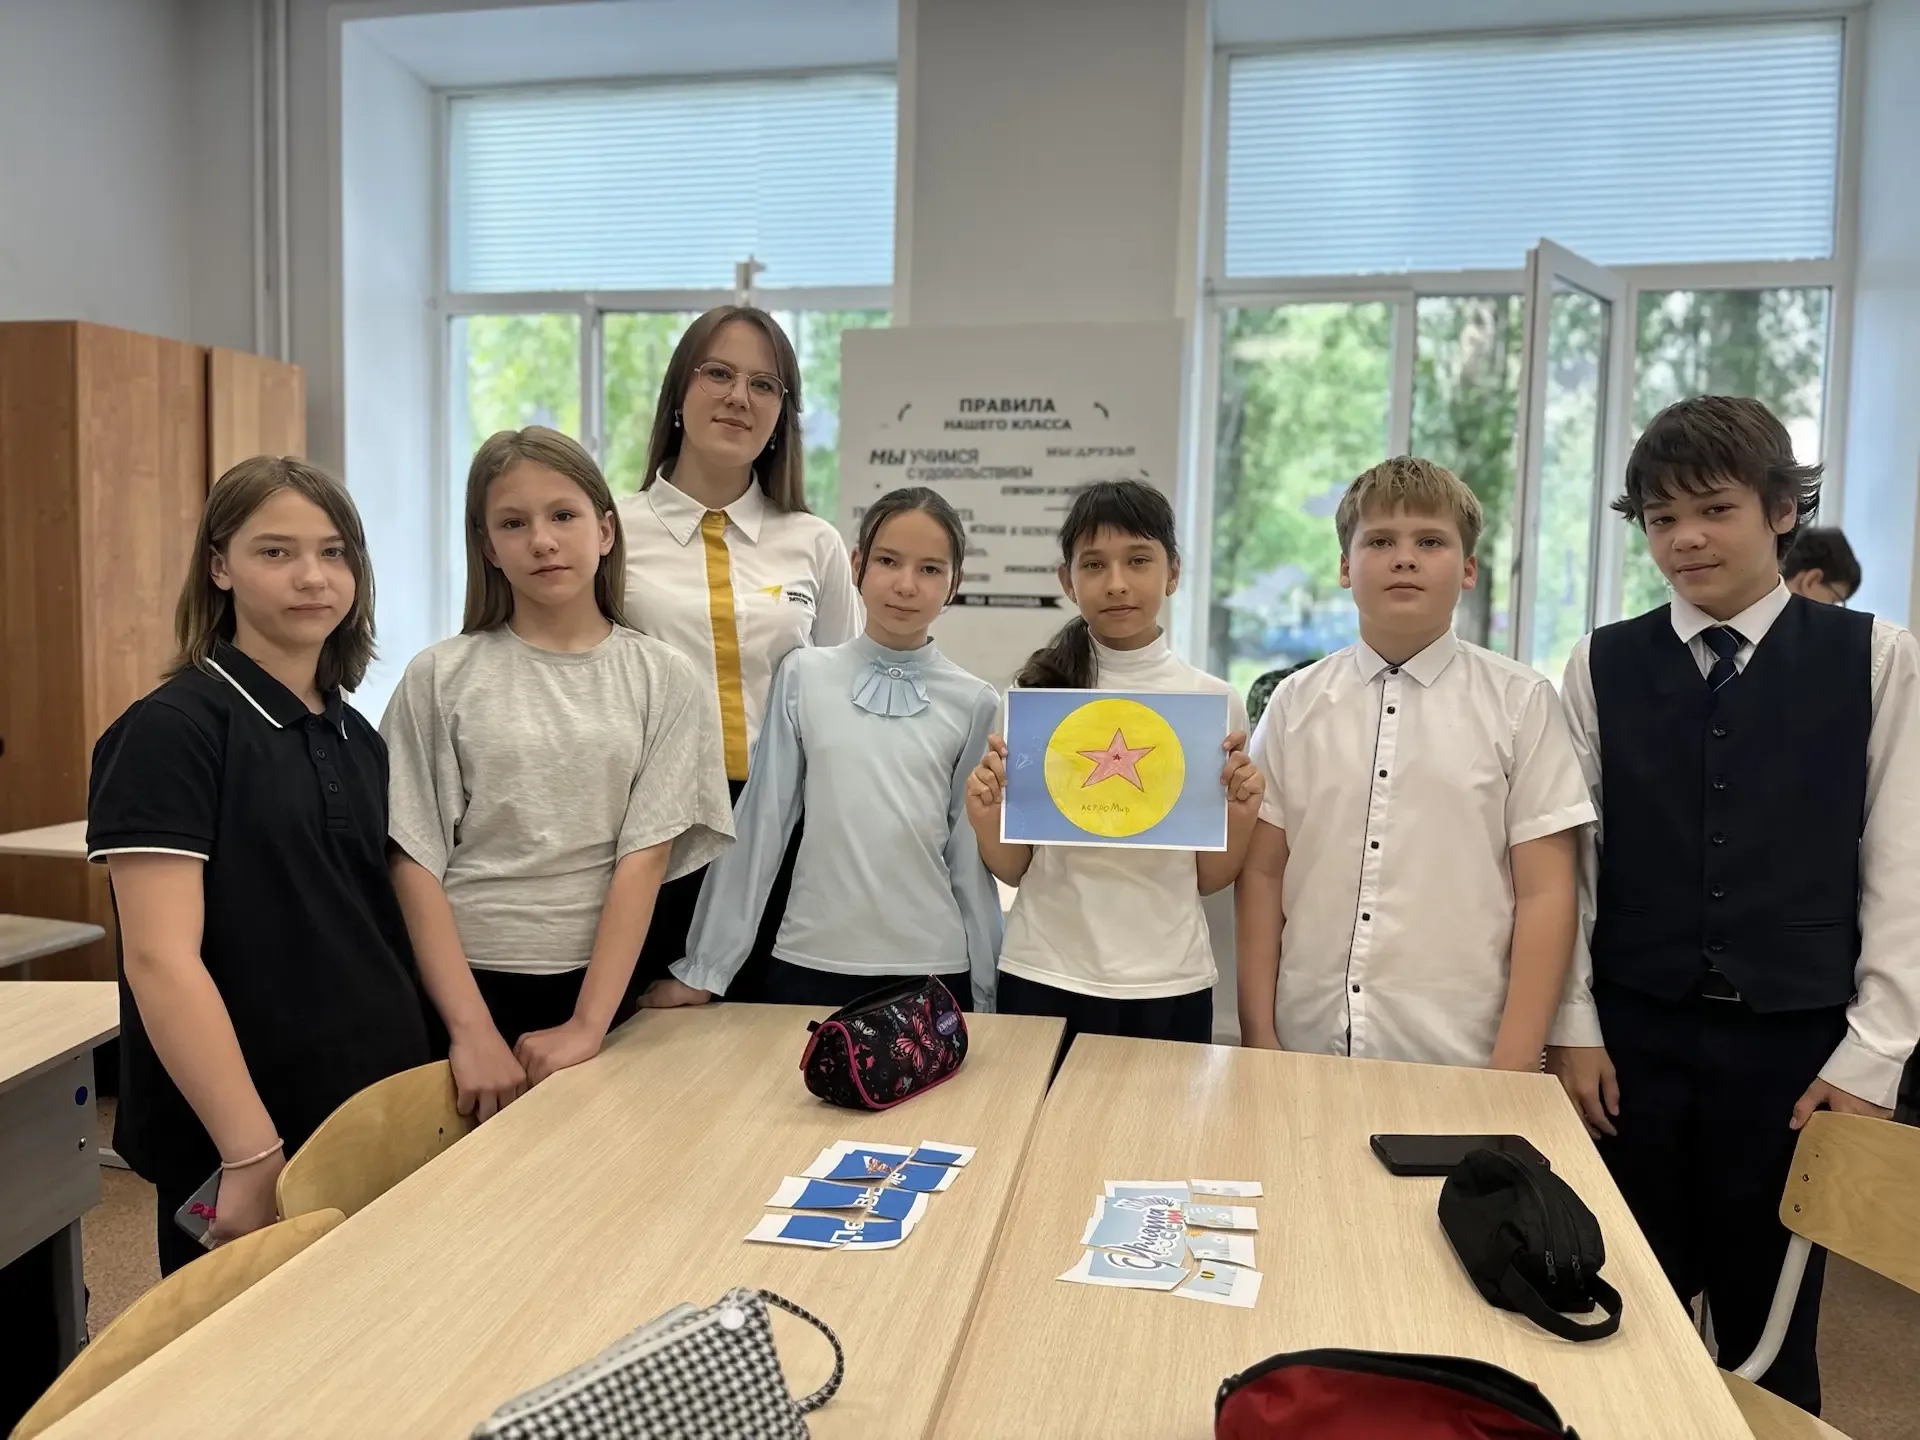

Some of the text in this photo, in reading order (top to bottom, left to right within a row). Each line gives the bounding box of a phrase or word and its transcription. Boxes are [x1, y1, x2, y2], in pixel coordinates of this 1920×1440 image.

[959, 398, 1056, 413] ПРАВИЛА
[944, 418, 1072, 431] НАШЕГО КЛАССА
[869, 448, 979, 465] МЫ УЧИМСЯ
